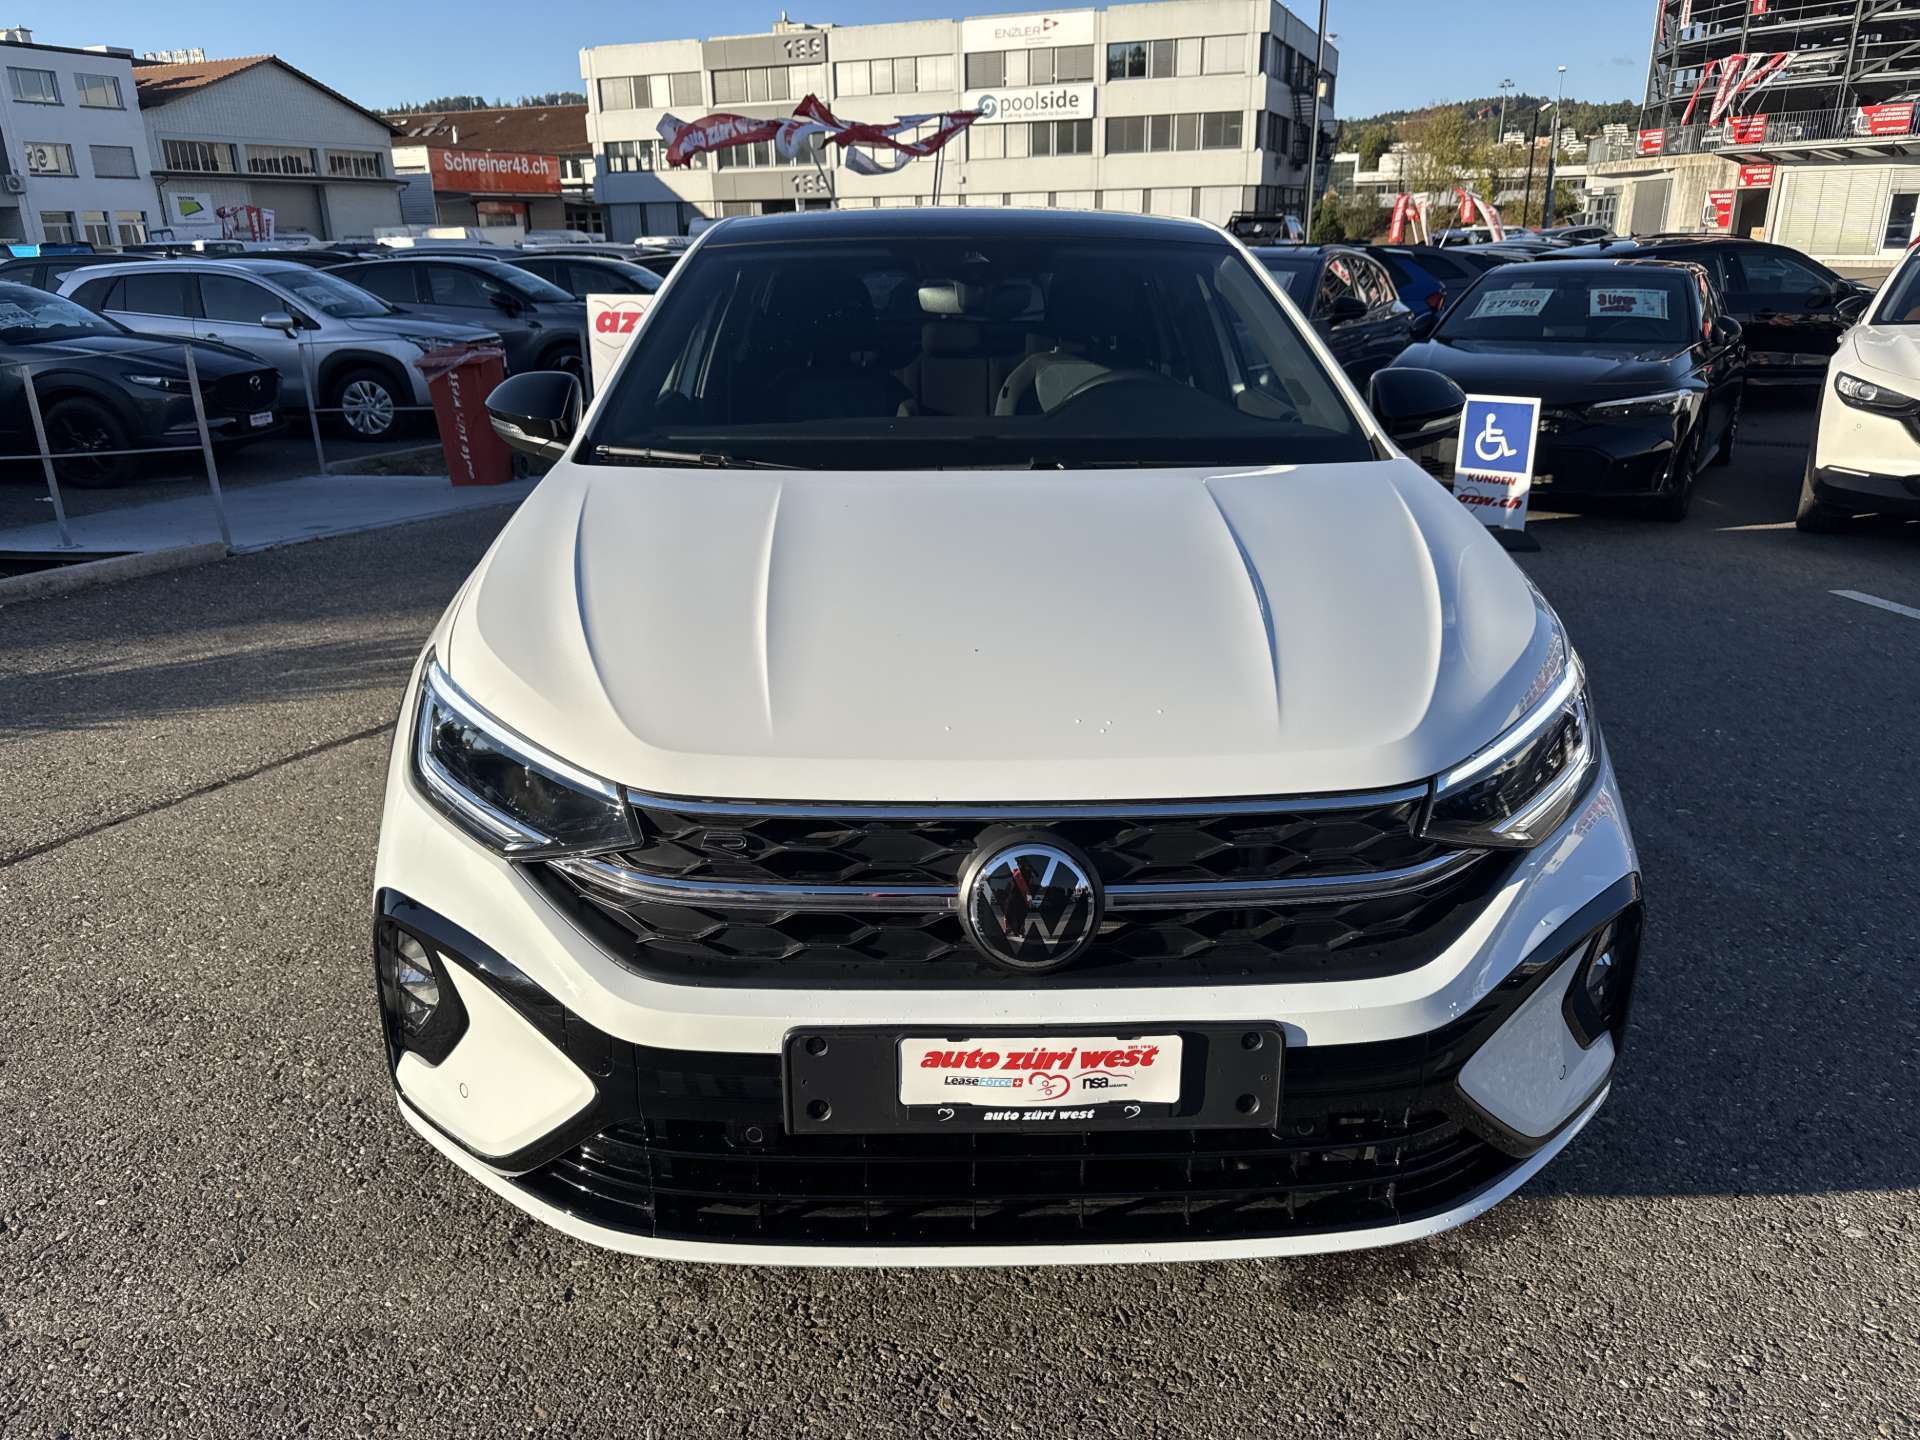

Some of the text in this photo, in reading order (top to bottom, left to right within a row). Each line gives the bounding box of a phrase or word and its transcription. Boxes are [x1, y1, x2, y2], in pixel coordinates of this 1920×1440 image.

[994, 26, 1041, 39] ENZLER
[784, 38, 821, 59] 139
[1000, 89, 1080, 118] poolside
[443, 151, 549, 175] Schreiner48.ch
[792, 173, 828, 193] 139
[1467, 473, 1517, 486] KUNDEN
[1457, 494, 1523, 509] azw.ch
[920, 1046, 1162, 1070] auto züri west
[1082, 1077, 1109, 1090] nsa
[984, 1109, 1095, 1121] auto züri west
